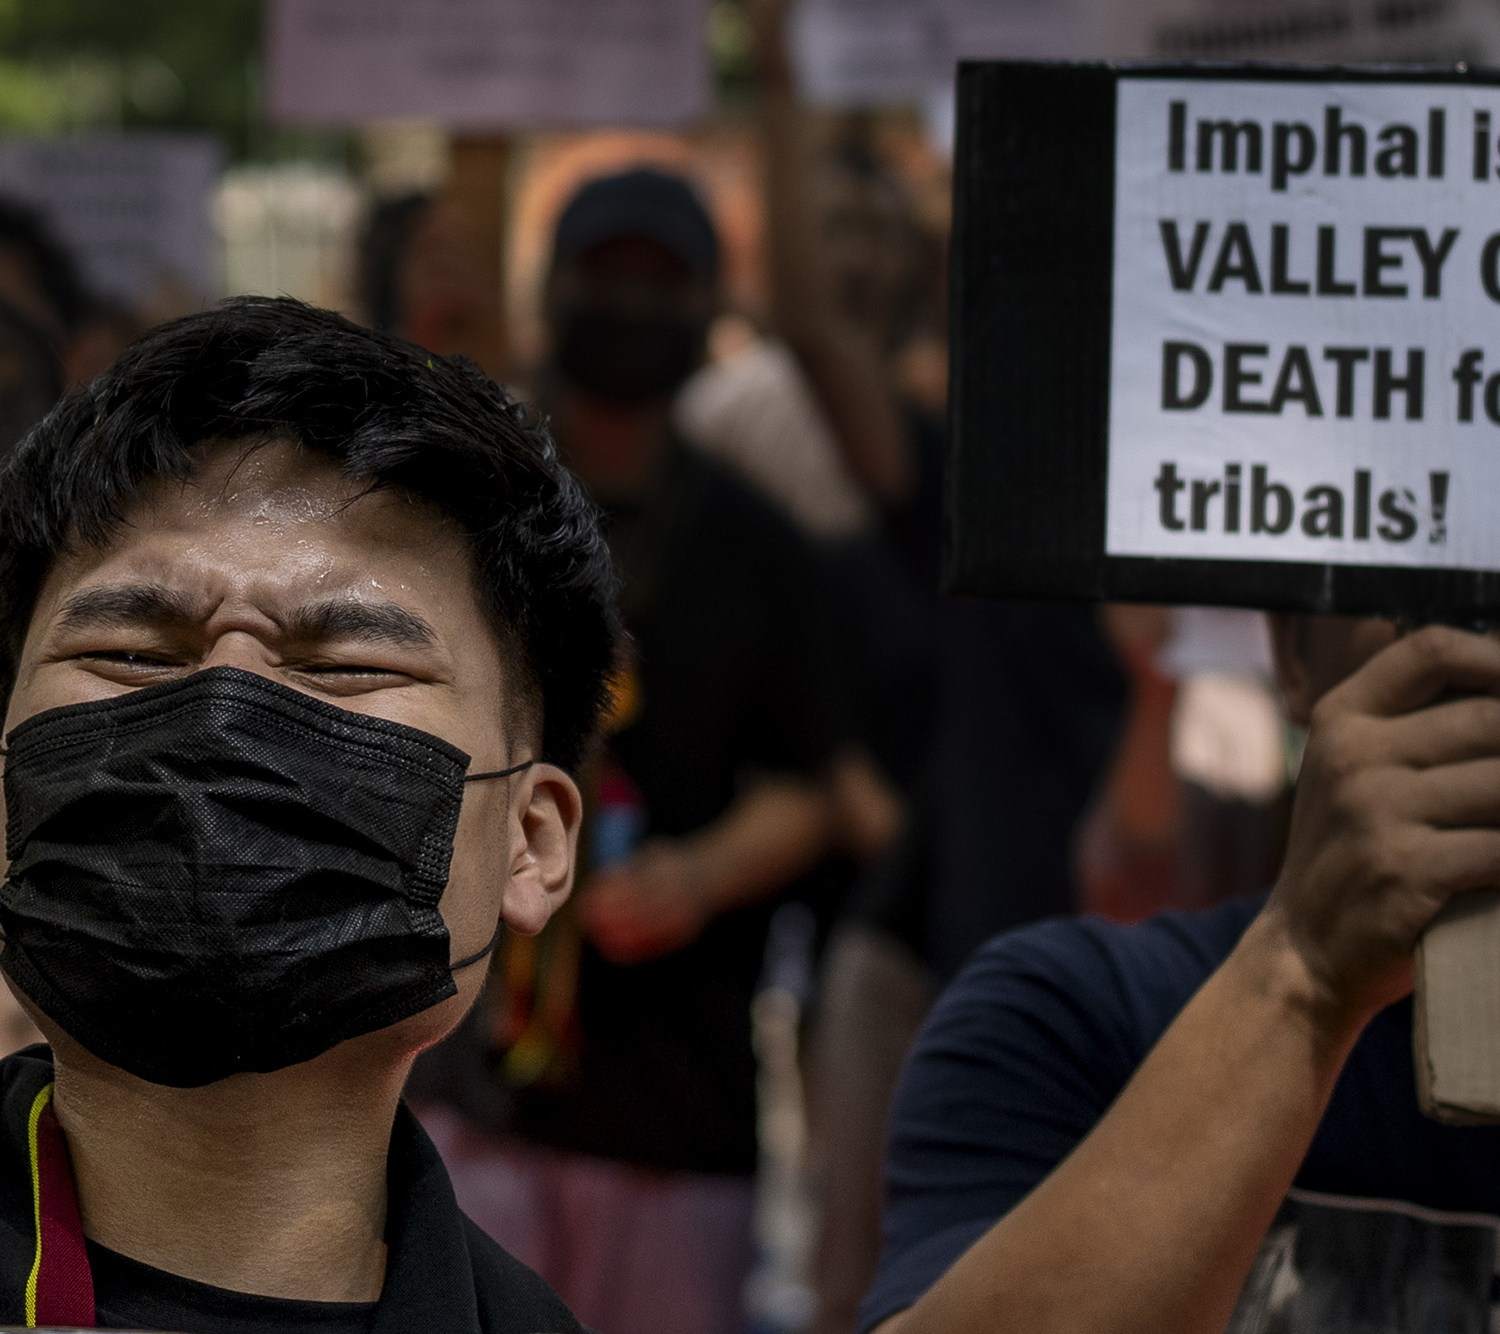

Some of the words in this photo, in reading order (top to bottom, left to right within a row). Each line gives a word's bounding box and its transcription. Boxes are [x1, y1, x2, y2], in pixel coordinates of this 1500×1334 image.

[1166, 99, 1447, 194] Imphal
[1158, 218, 1461, 300] VALLEY
[1160, 339, 1427, 423] DEATH
[1152, 461, 1452, 546] tribals!
